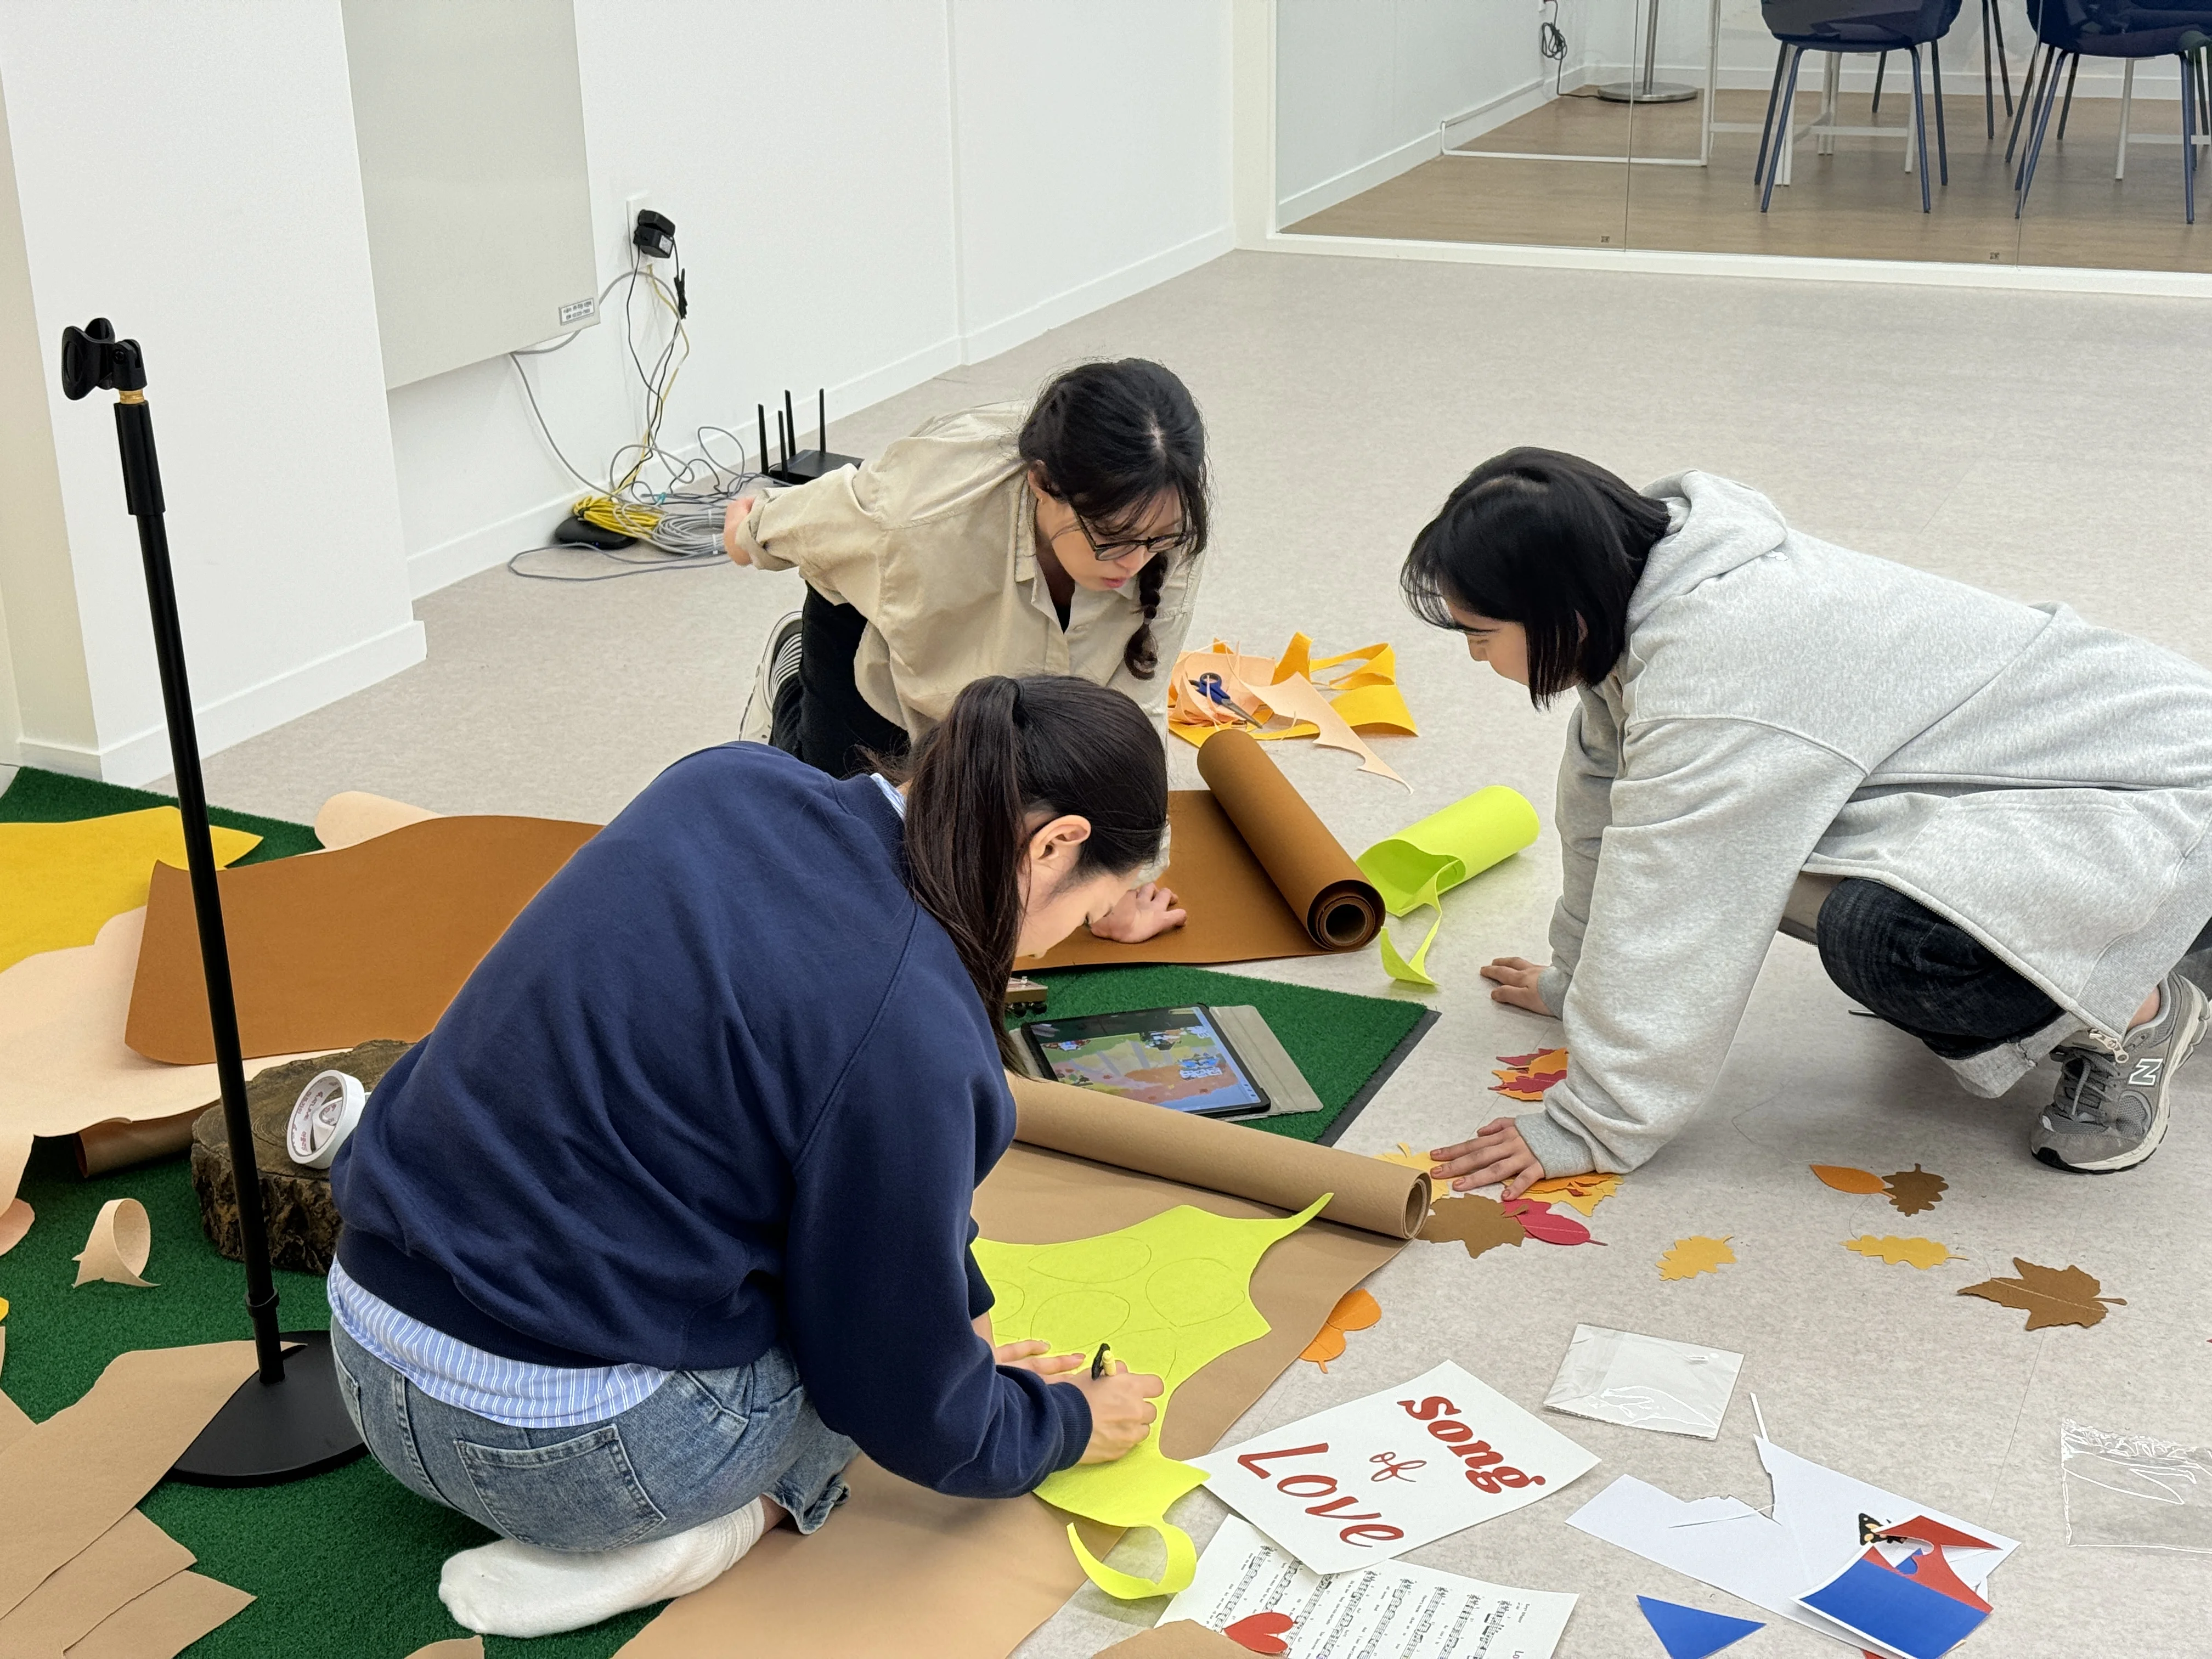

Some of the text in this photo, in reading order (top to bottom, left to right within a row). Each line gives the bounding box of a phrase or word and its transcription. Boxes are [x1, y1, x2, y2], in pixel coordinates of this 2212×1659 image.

[2129, 1058, 2163, 1085] N
[1369, 1452, 1426, 1482] of
[1397, 1396, 1545, 1493] Song
[1238, 1443, 1404, 1547] Love
